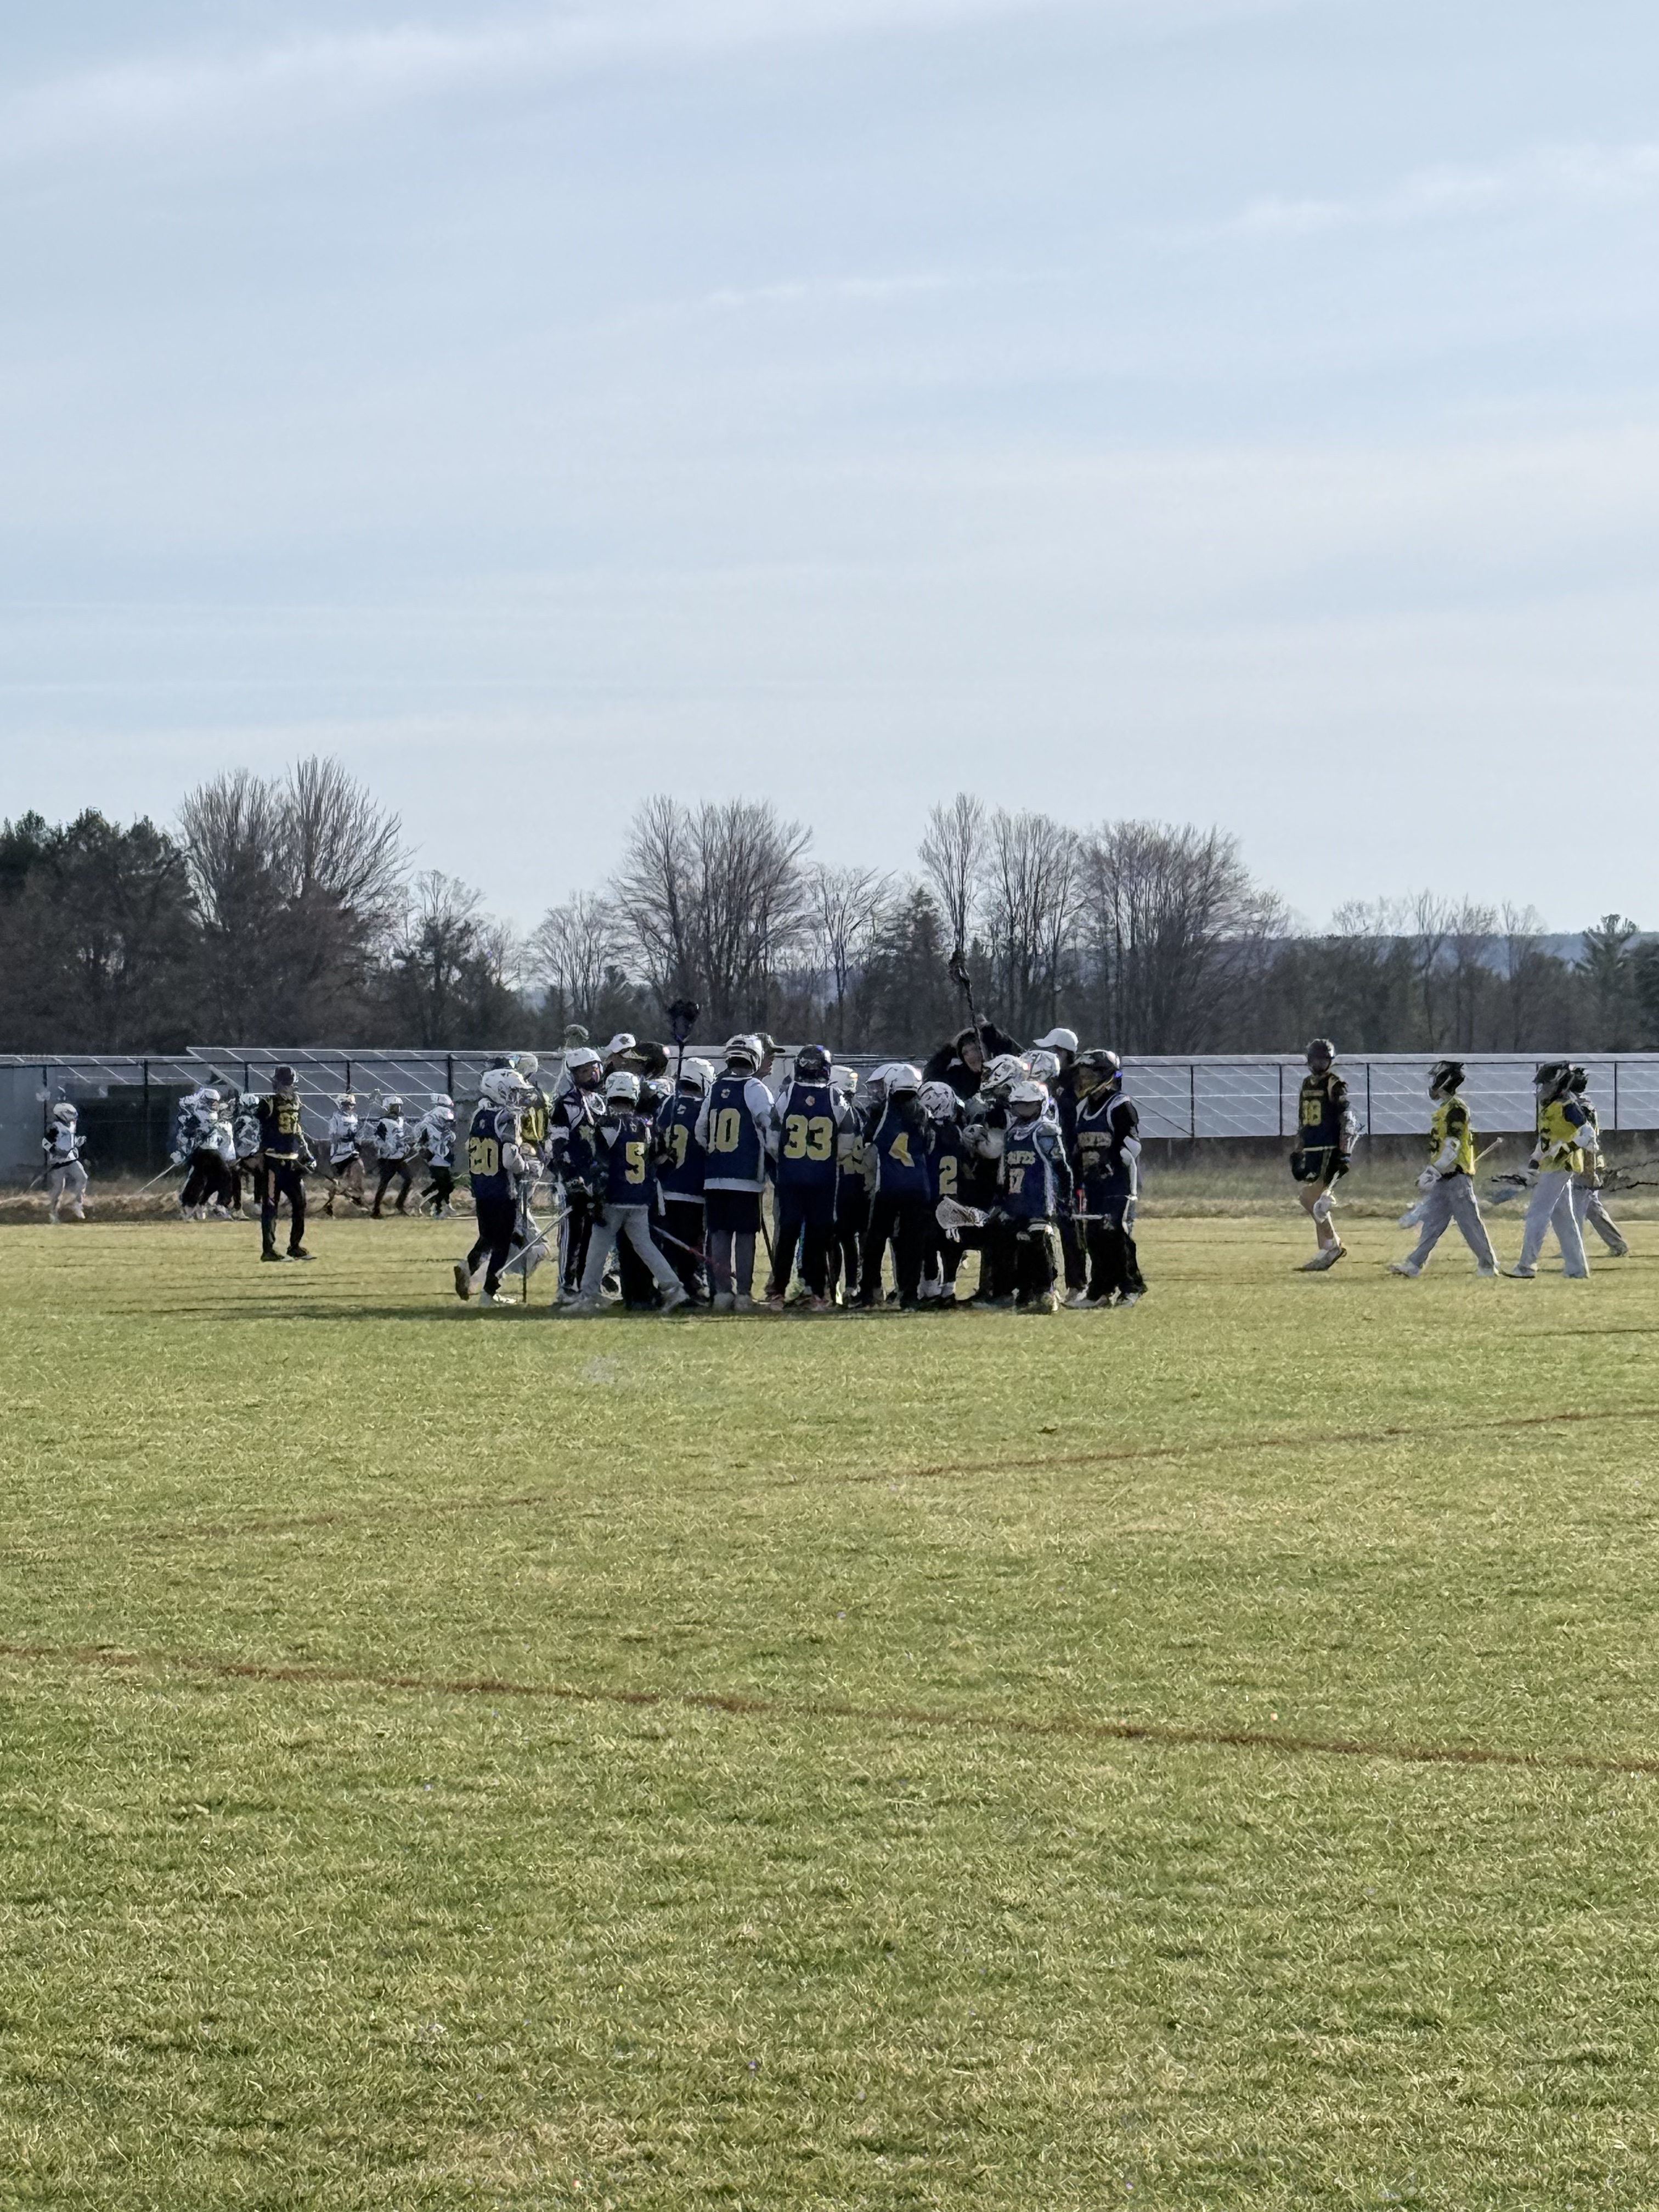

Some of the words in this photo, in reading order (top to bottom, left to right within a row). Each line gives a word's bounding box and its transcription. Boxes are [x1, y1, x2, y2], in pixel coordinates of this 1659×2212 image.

[708, 1108, 741, 1153] 10
[783, 1114, 833, 1160] 33
[625, 1142, 645, 1184] 5
[939, 1156, 957, 1194] 2
